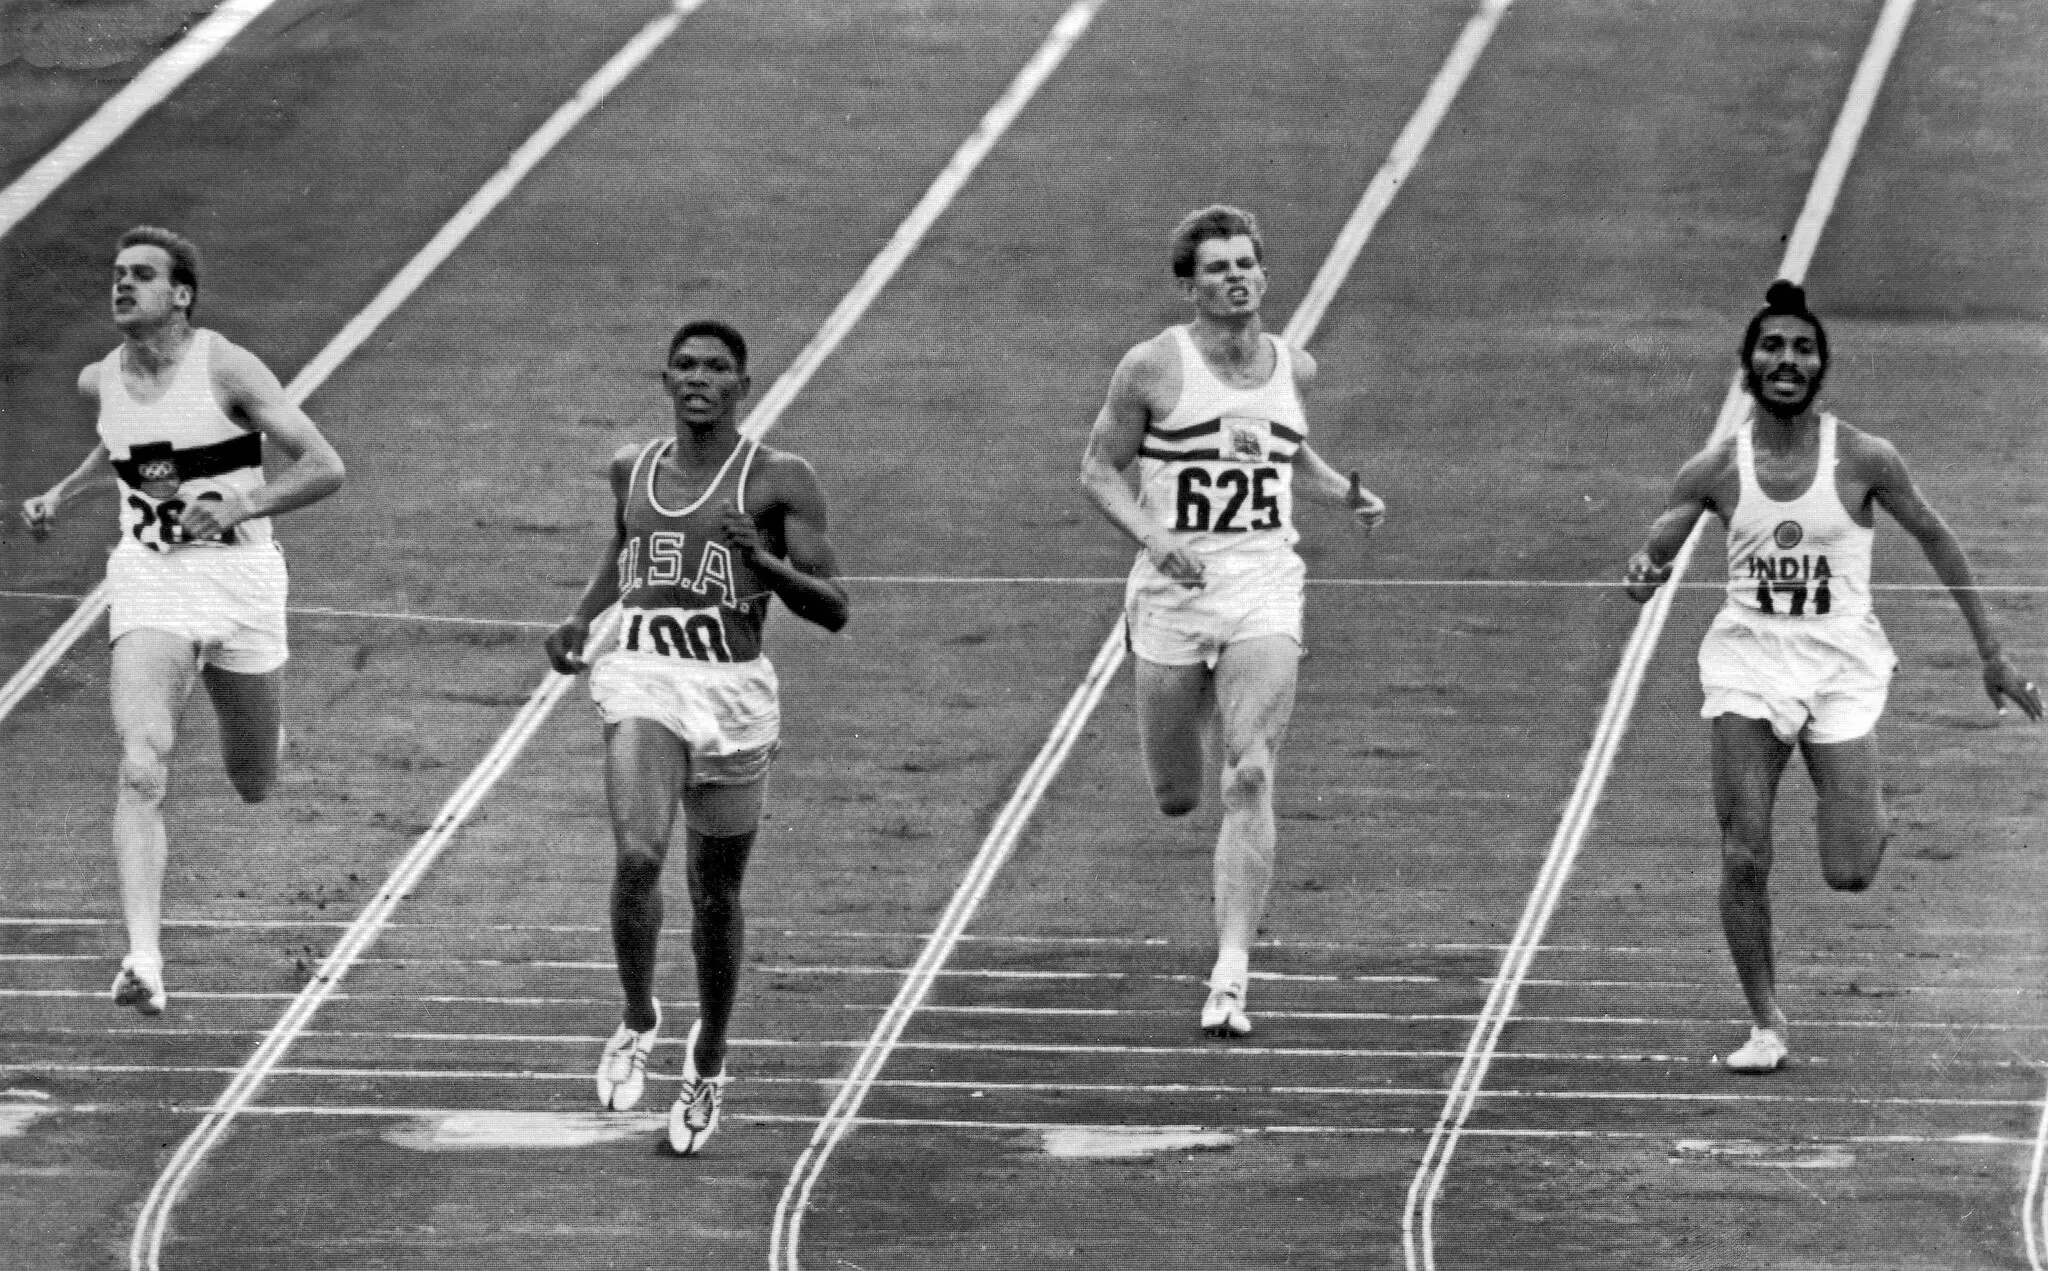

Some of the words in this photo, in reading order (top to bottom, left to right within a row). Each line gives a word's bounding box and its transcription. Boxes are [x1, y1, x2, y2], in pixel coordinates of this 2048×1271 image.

[1176, 467, 1282, 532] 625
[1749, 555, 1832, 580] INDIA
[1756, 579, 1831, 615] 171
[626, 614, 732, 663] 100
